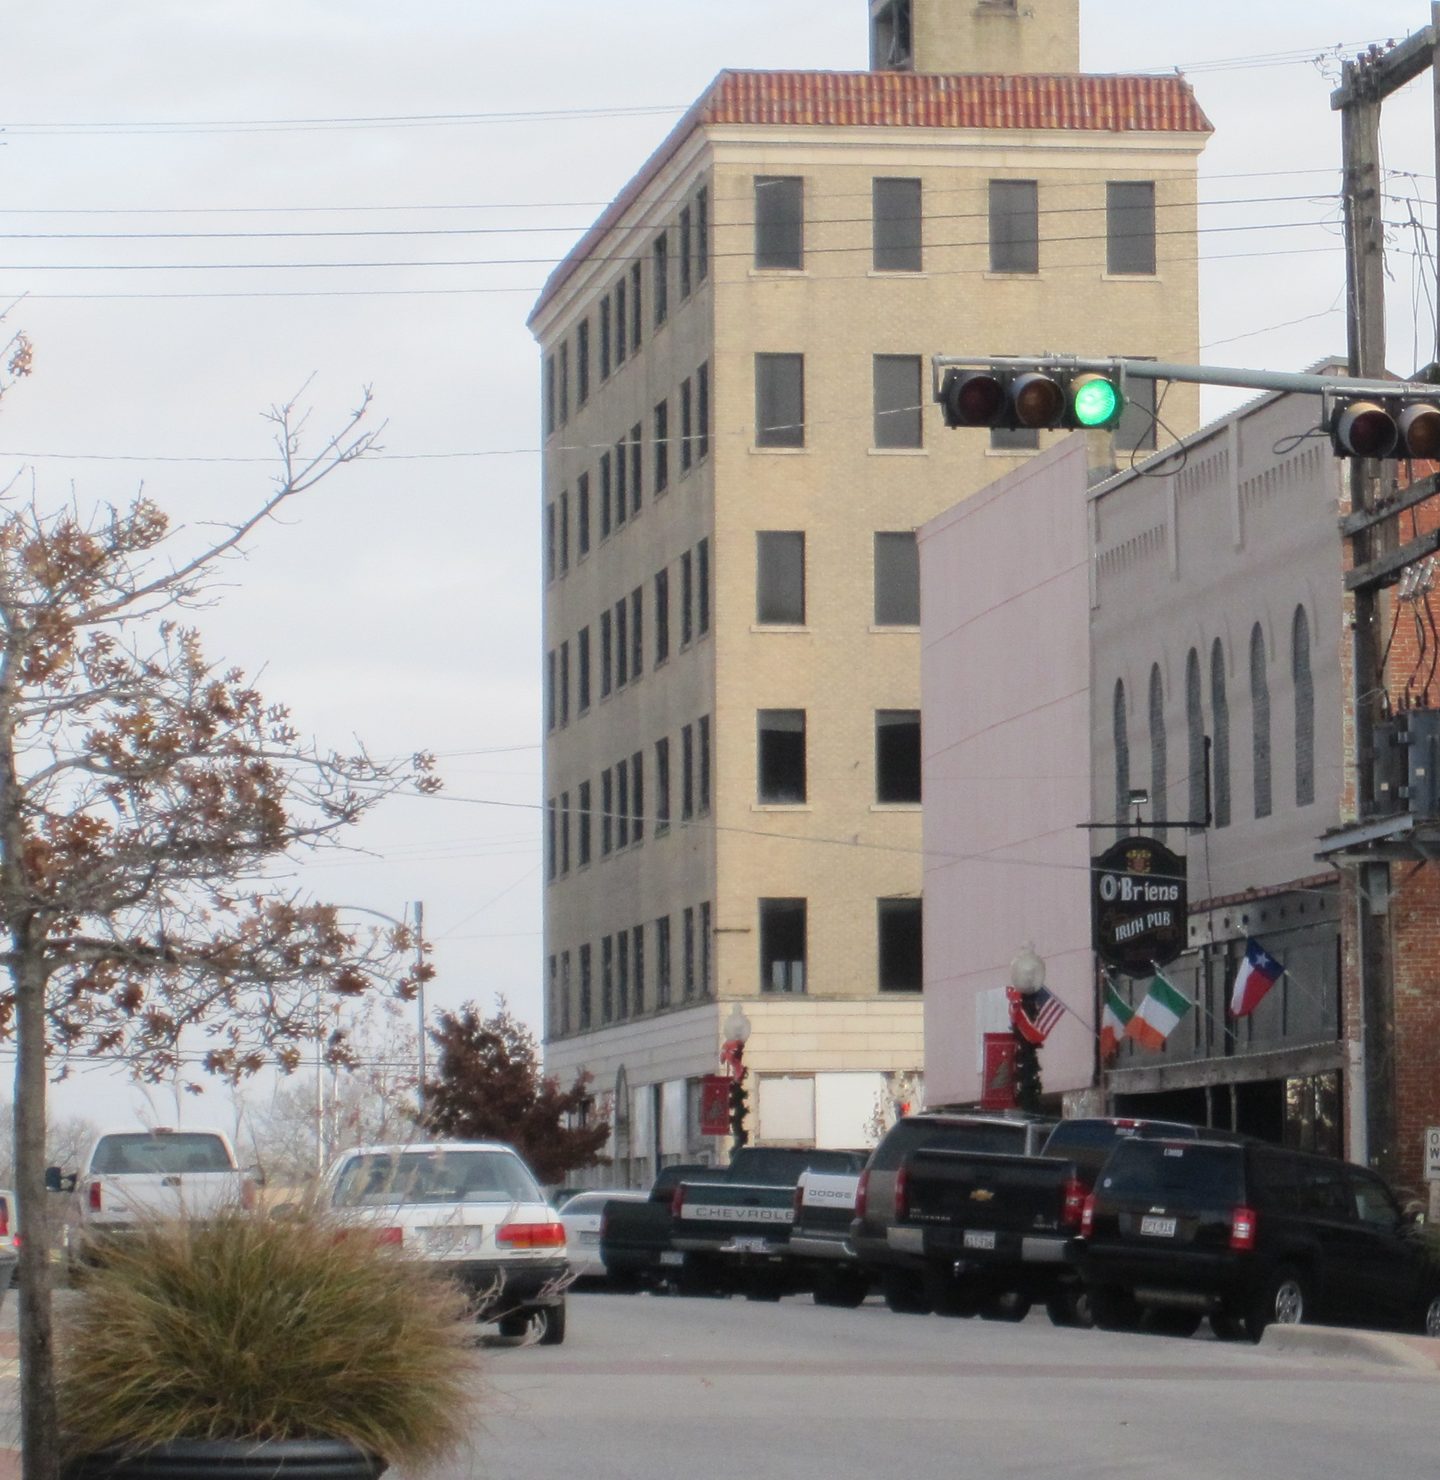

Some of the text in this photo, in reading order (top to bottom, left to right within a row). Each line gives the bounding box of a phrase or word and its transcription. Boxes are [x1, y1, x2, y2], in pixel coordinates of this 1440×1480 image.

[1100, 875, 1179, 901] O'Briens
[1115, 911, 1171, 941] IRISH PUB
[695, 1206, 795, 1220] CHEVROLE
